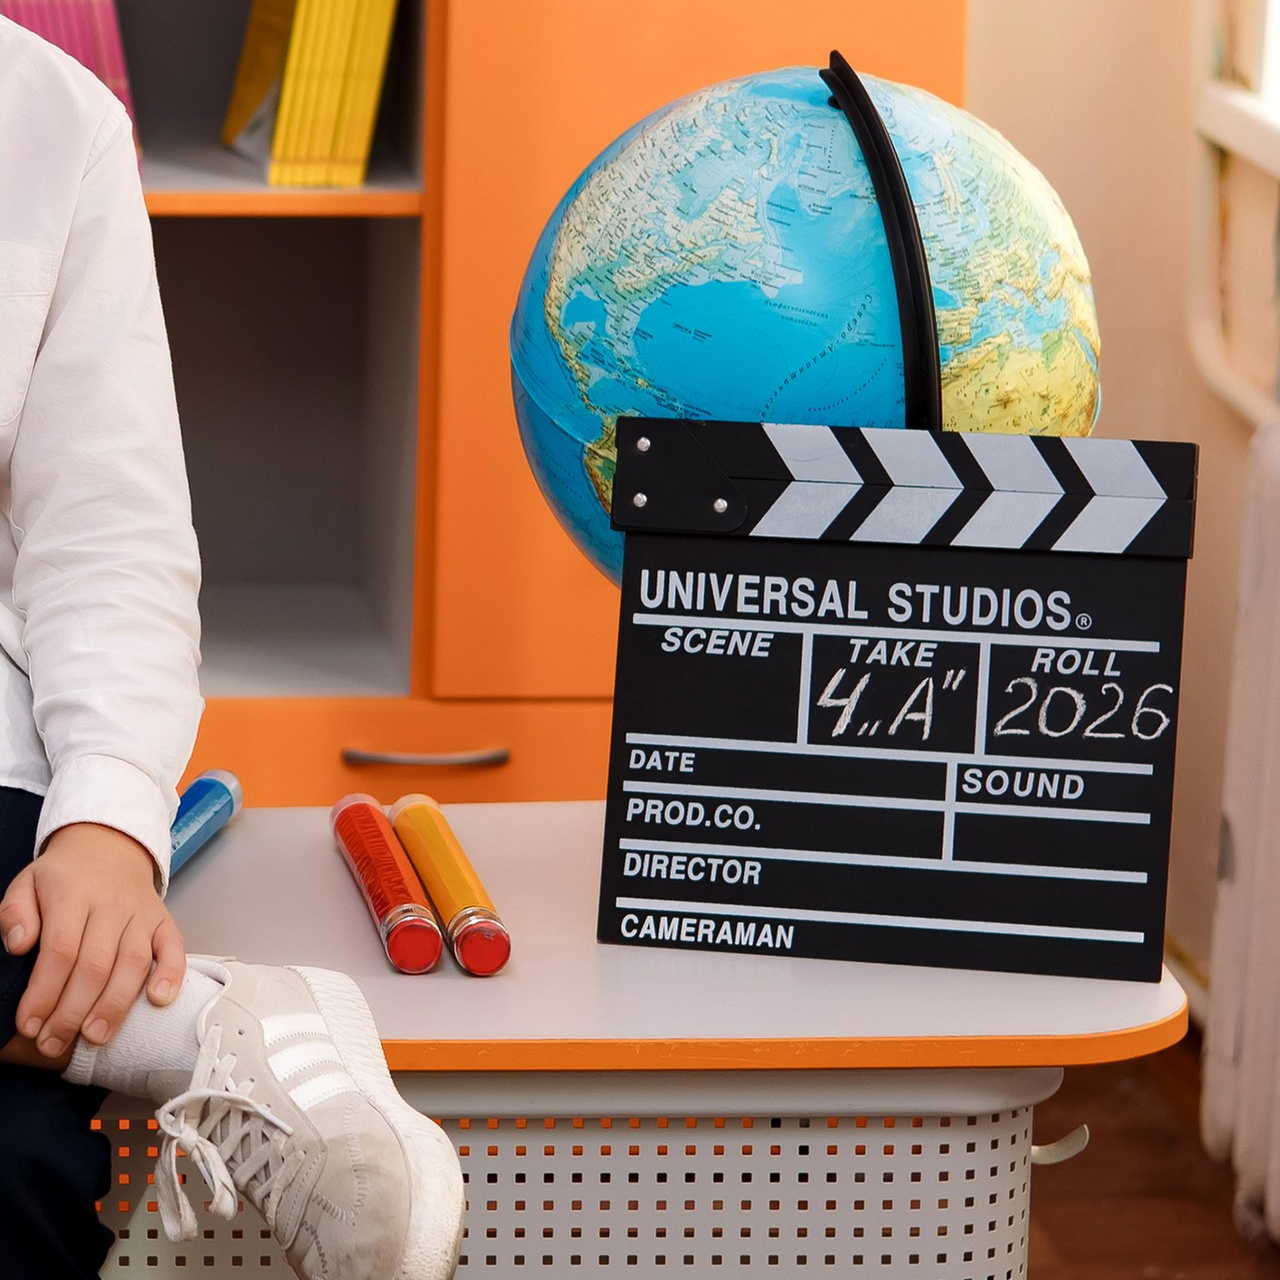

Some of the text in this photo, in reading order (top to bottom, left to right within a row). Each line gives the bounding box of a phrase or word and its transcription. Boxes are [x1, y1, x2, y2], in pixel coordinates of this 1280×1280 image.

[641, 570, 868, 619] UNIVERSAL
[661, 627, 774, 657] SCENE
[850, 639, 937, 667] TAKE
[1031, 648, 1120, 676] ROLL
[994, 677, 1173, 739] 2026
[629, 750, 695, 772] DATE
[962, 769, 1084, 799] SOUND
[627, 798, 760, 830] PROD.CO.
[624, 853, 761, 884] DIRECTOR
[621, 914, 794, 948] CAMERAMAN
